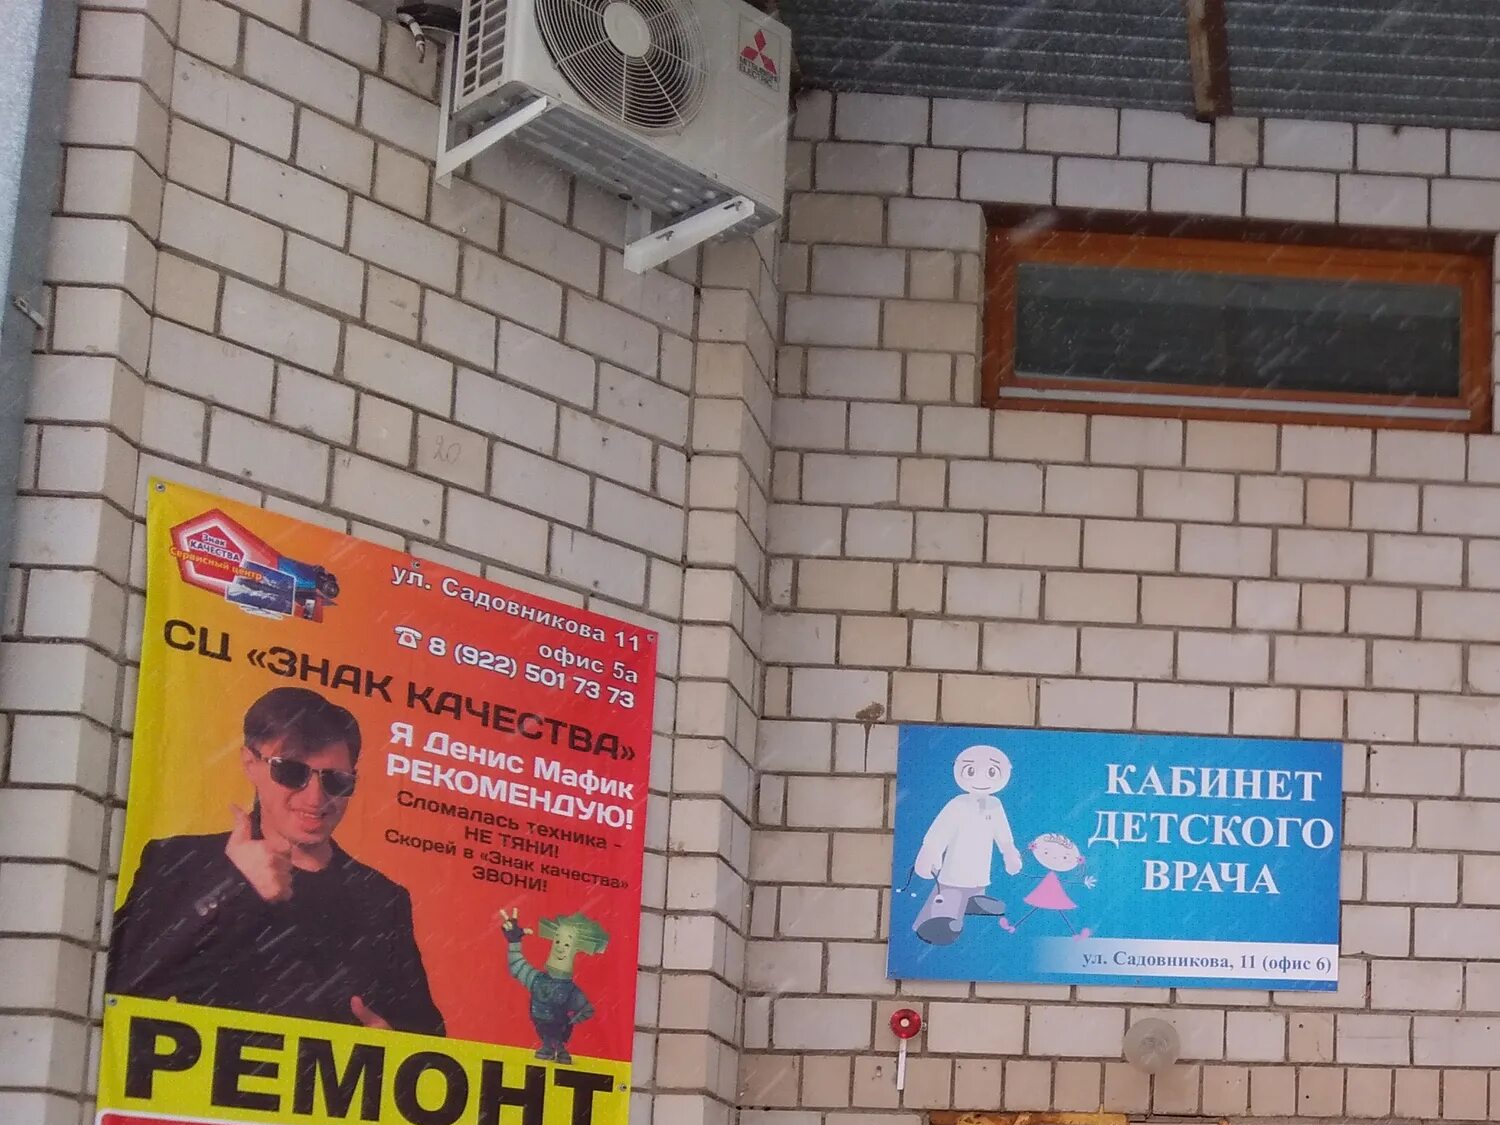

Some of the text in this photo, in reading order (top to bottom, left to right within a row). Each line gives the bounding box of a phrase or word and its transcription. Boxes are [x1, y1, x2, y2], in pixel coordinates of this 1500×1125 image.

[189, 540, 241, 562] КАЧЕСТВА
[202, 533, 226, 546] Знак
[169, 547, 263, 582] Сервисный центр
[391, 566, 640, 652] ул. Садовникова 11
[428, 637, 635, 709] 8 (922) 501 73 73
[538, 645, 639, 684] офис 5а
[163, 619, 636, 761] СЦ «ЗНАК КАЧЕСТВА»
[389, 721, 635, 800] Я Денис Мафик
[386, 753, 634, 830] РЕКОМЕНДУЮ!
[1105, 763, 1322, 802] КАБИНЕТ
[396, 790, 520, 831] Сломалась
[527, 821, 608, 851] техника
[1087, 809, 1334, 849] ДЕТСКОГО
[384, 828, 629, 890] Скорей в «Знак качества»
[464, 826, 560, 860] НЕ ТЯНИ!
[471, 865, 548, 893] ЗВОНИ!
[1141, 860, 1280, 895] ВРАЧА
[1082, 950, 1332, 975] ул. Садовникова, 11 (офис 6)
